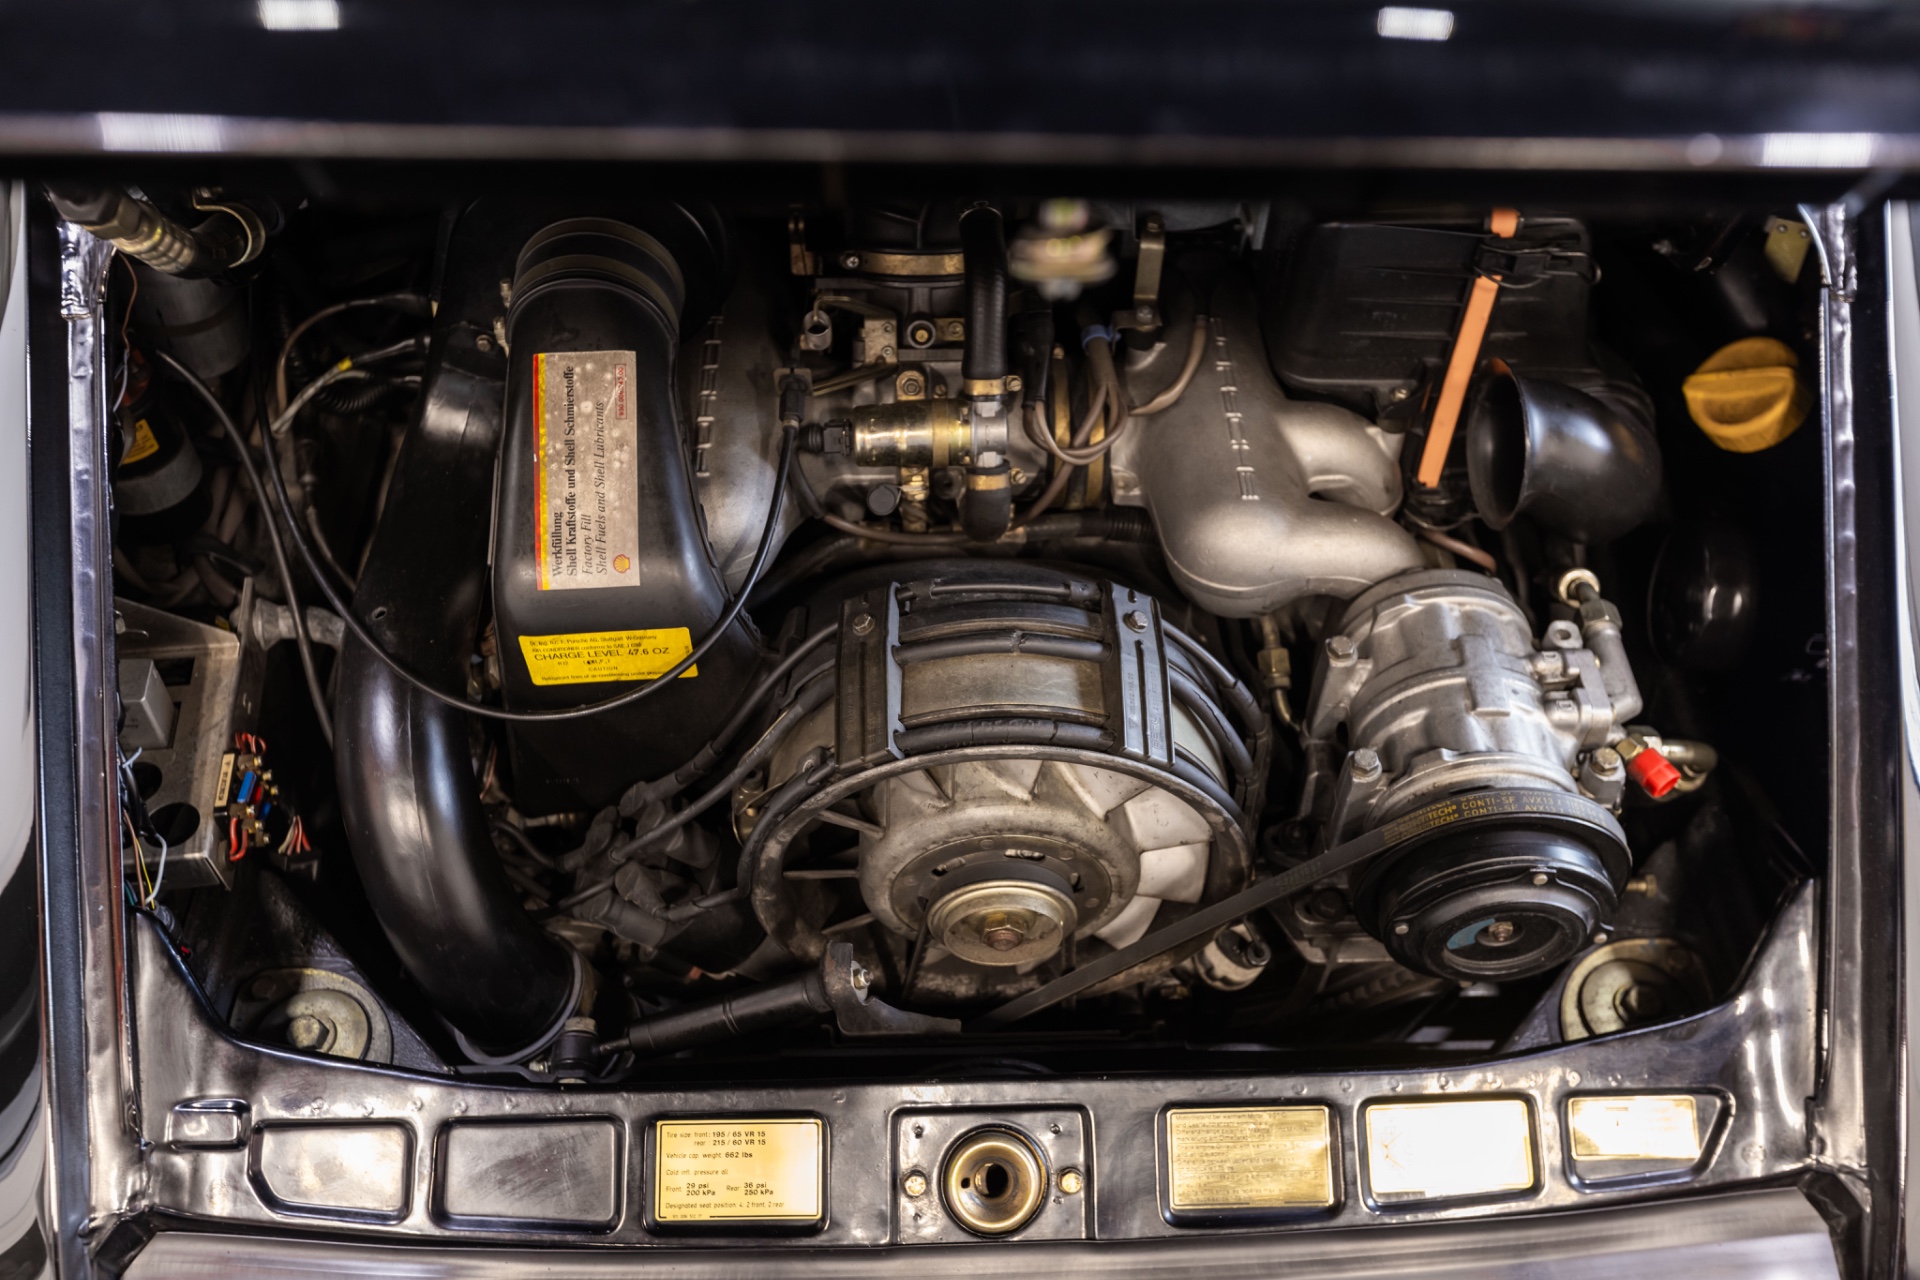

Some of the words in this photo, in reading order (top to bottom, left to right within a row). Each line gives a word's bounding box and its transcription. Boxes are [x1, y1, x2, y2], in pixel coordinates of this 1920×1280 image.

[563, 366, 575, 436] Schmierstoffe
[594, 402, 605, 458] Lubricants
[564, 439, 576, 466] Shell
[565, 469, 576, 489] und
[594, 462, 606, 489] Shell
[595, 492, 606, 512] and
[565, 492, 577, 545] Kraftstoffe
[580, 514, 592, 532] Fill
[595, 516, 606, 544] Fuels
[552, 512, 564, 576] Werkfüllung
[581, 535, 594, 575] Factory
[566, 549, 578, 576] Shell
[596, 547, 607, 575] Shell
[534, 651, 585, 661] CHARGE
[587, 649, 624, 658] LEVEL
[627, 648, 649, 656] 47.6
[652, 647, 670, 655] OZ
[1462, 796, 1515, 810] CONTI-SF
[1522, 796, 1554, 806] AVX13
